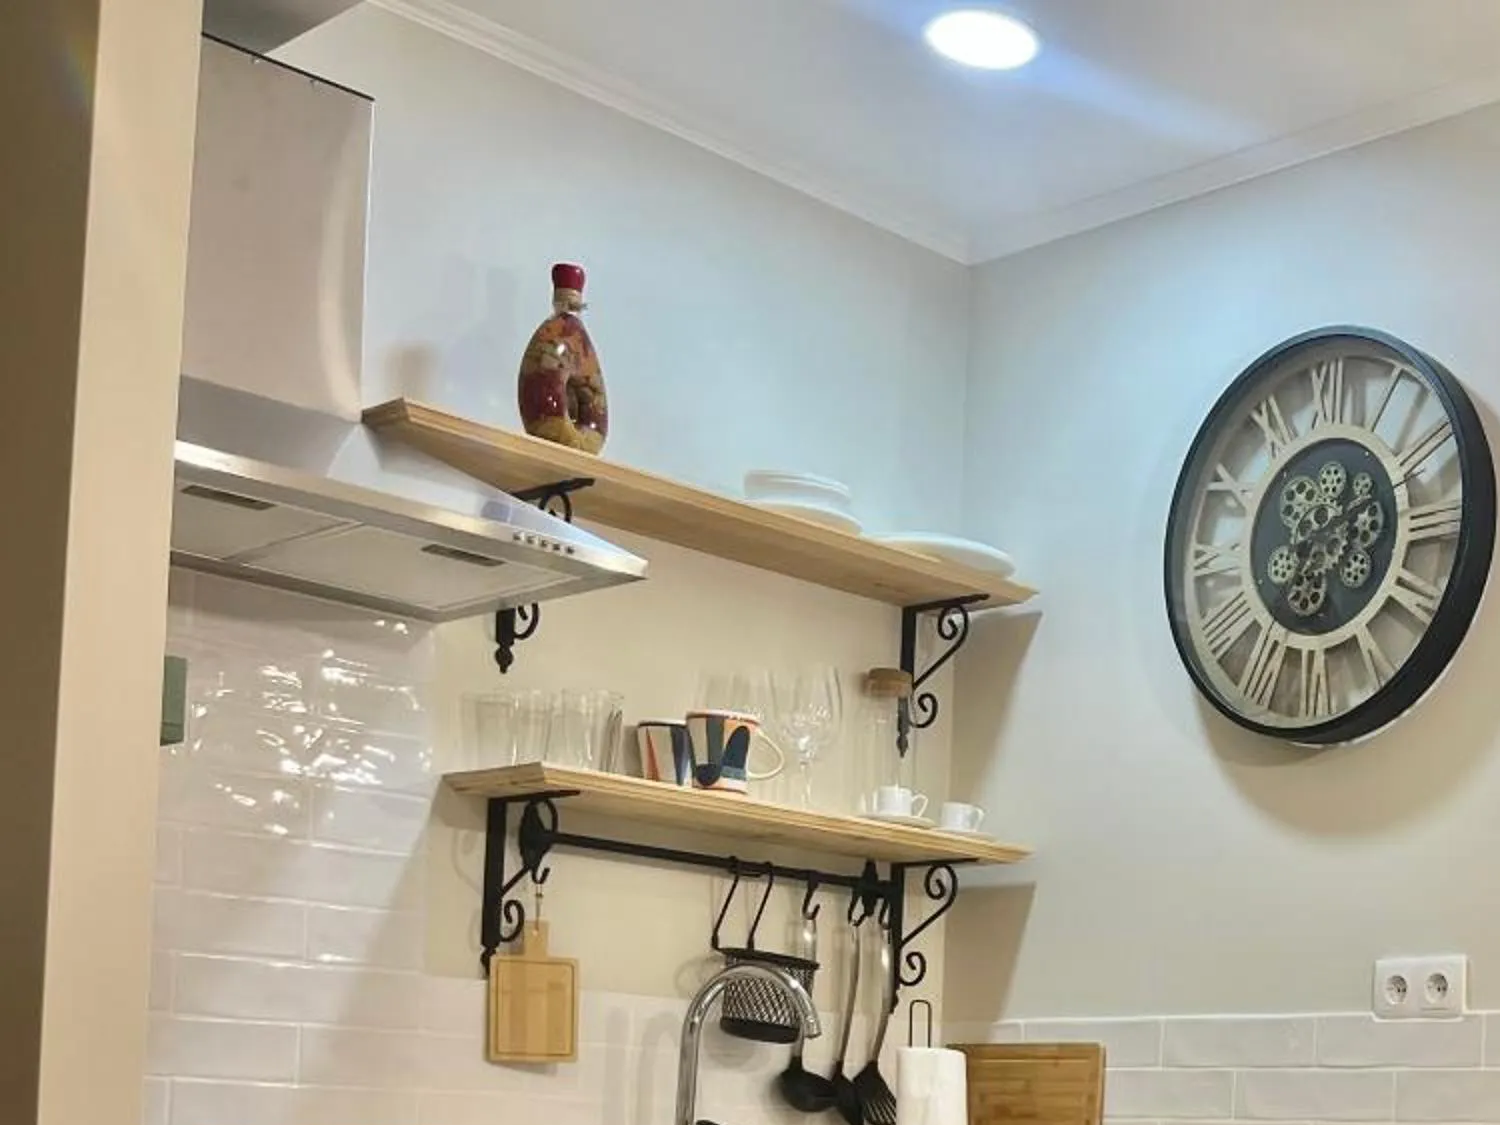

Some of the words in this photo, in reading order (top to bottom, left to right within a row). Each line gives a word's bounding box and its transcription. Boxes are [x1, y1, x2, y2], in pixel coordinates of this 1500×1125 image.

[1308, 357, 1344, 430] XII
[1251, 395, 1292, 458] XI
[1396, 415, 1456, 475] II
[1207, 462, 1254, 510] X
[1404, 500, 1463, 541] III
[1199, 588, 1256, 662] VIII
[1240, 620, 1286, 710] VII
[1300, 648, 1336, 718] VI
[1355, 626, 1400, 688] V
